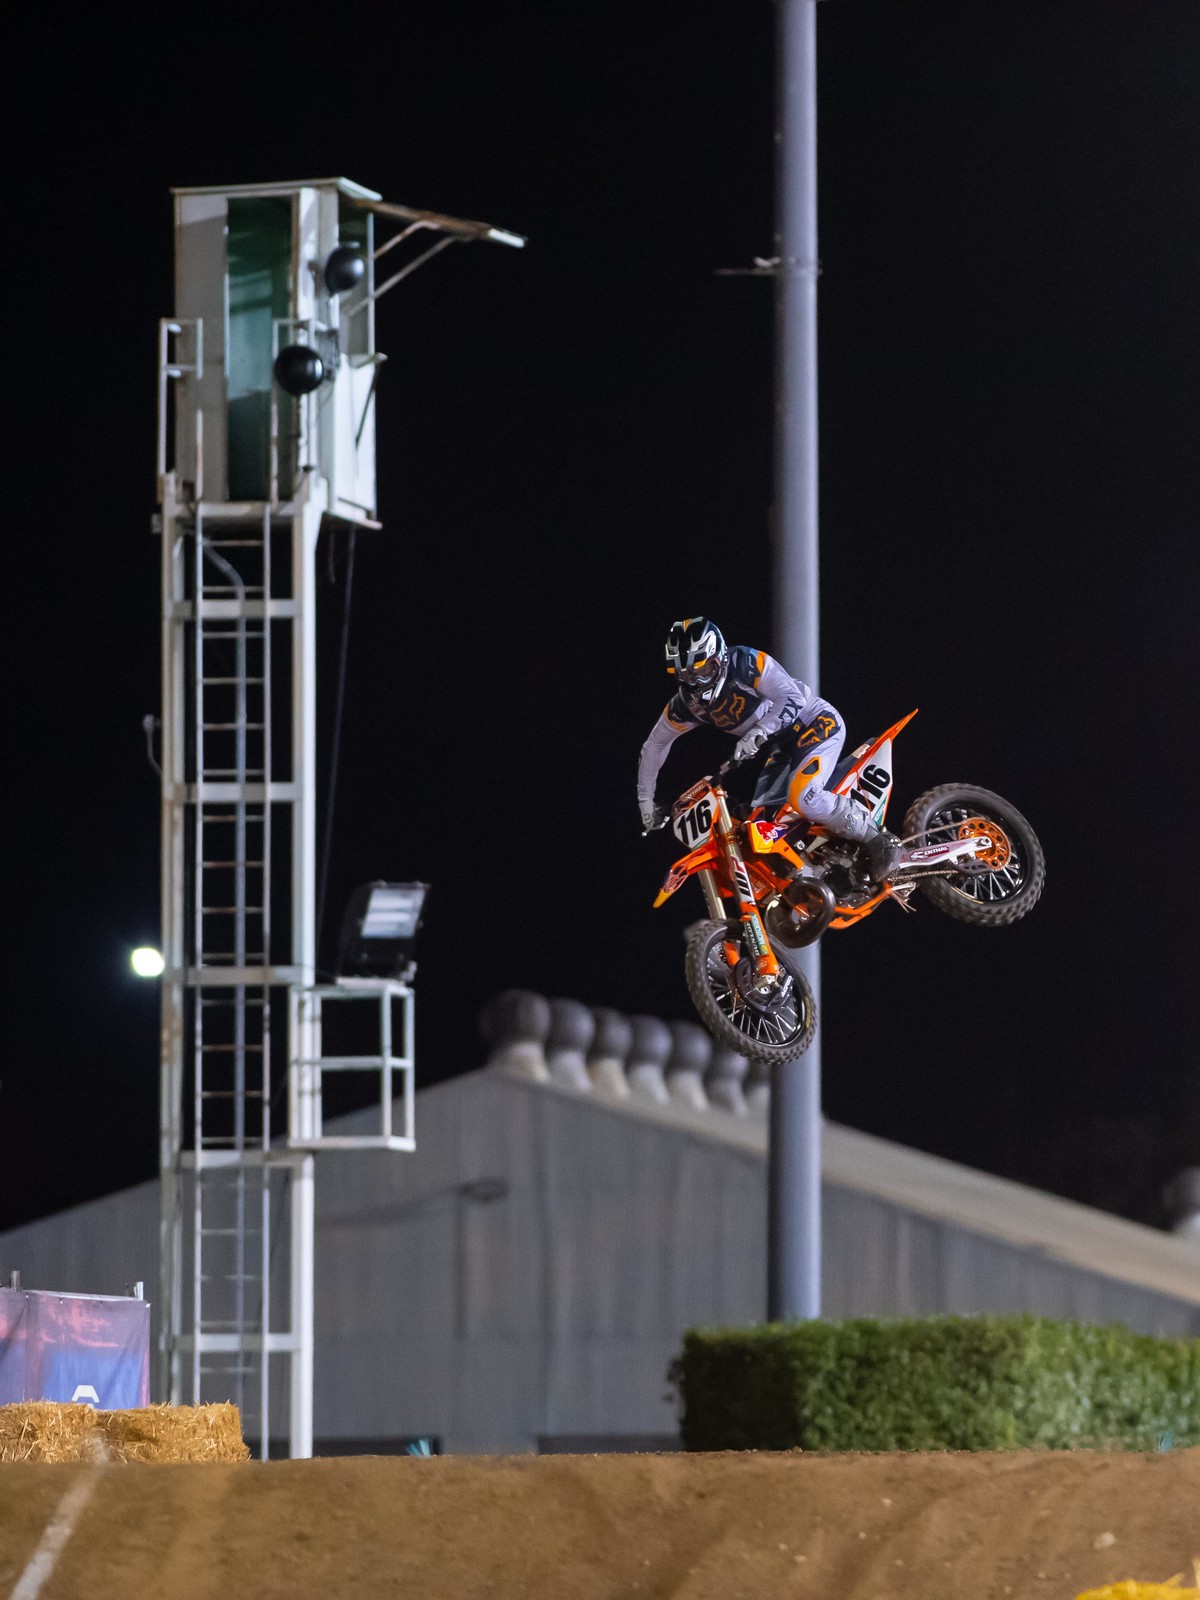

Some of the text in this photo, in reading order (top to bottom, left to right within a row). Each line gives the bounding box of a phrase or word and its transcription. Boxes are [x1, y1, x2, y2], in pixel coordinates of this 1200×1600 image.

[803, 786, 818, 805] FOX
[848, 764, 891, 812] 116
[677, 799, 713, 847] 116
